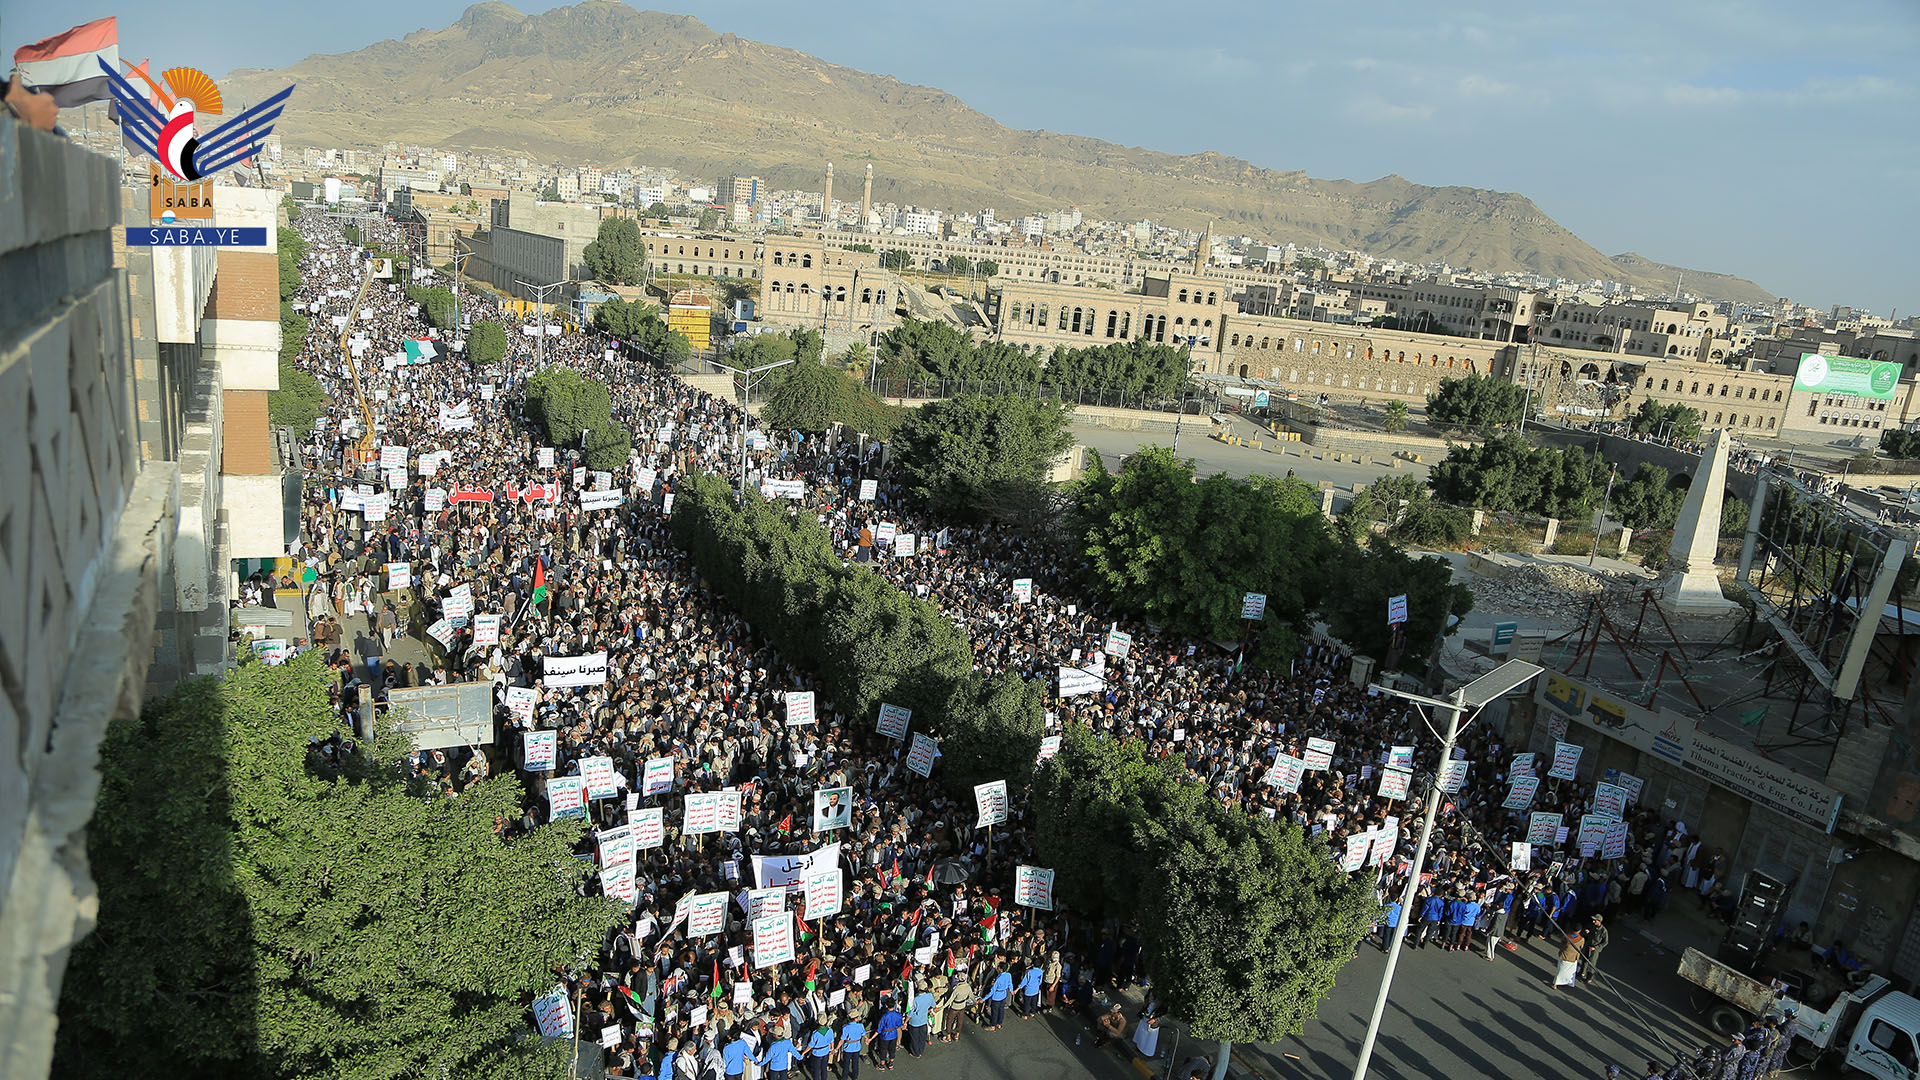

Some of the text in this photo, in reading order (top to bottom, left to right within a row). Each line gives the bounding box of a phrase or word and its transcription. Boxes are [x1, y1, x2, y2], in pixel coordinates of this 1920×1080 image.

[449, 482, 494, 505] محتل
[507, 481, 518, 503] يا
[524, 481, 559, 503] ارحل
[543, 664, 606, 678] صبرنا سينفد
[1690, 750, 1826, 818] Tihama Tractors & Eng. Co. Ltd
[1787, 778, 1808, 796] تهامة
[1809, 788, 1830, 806] شركة
